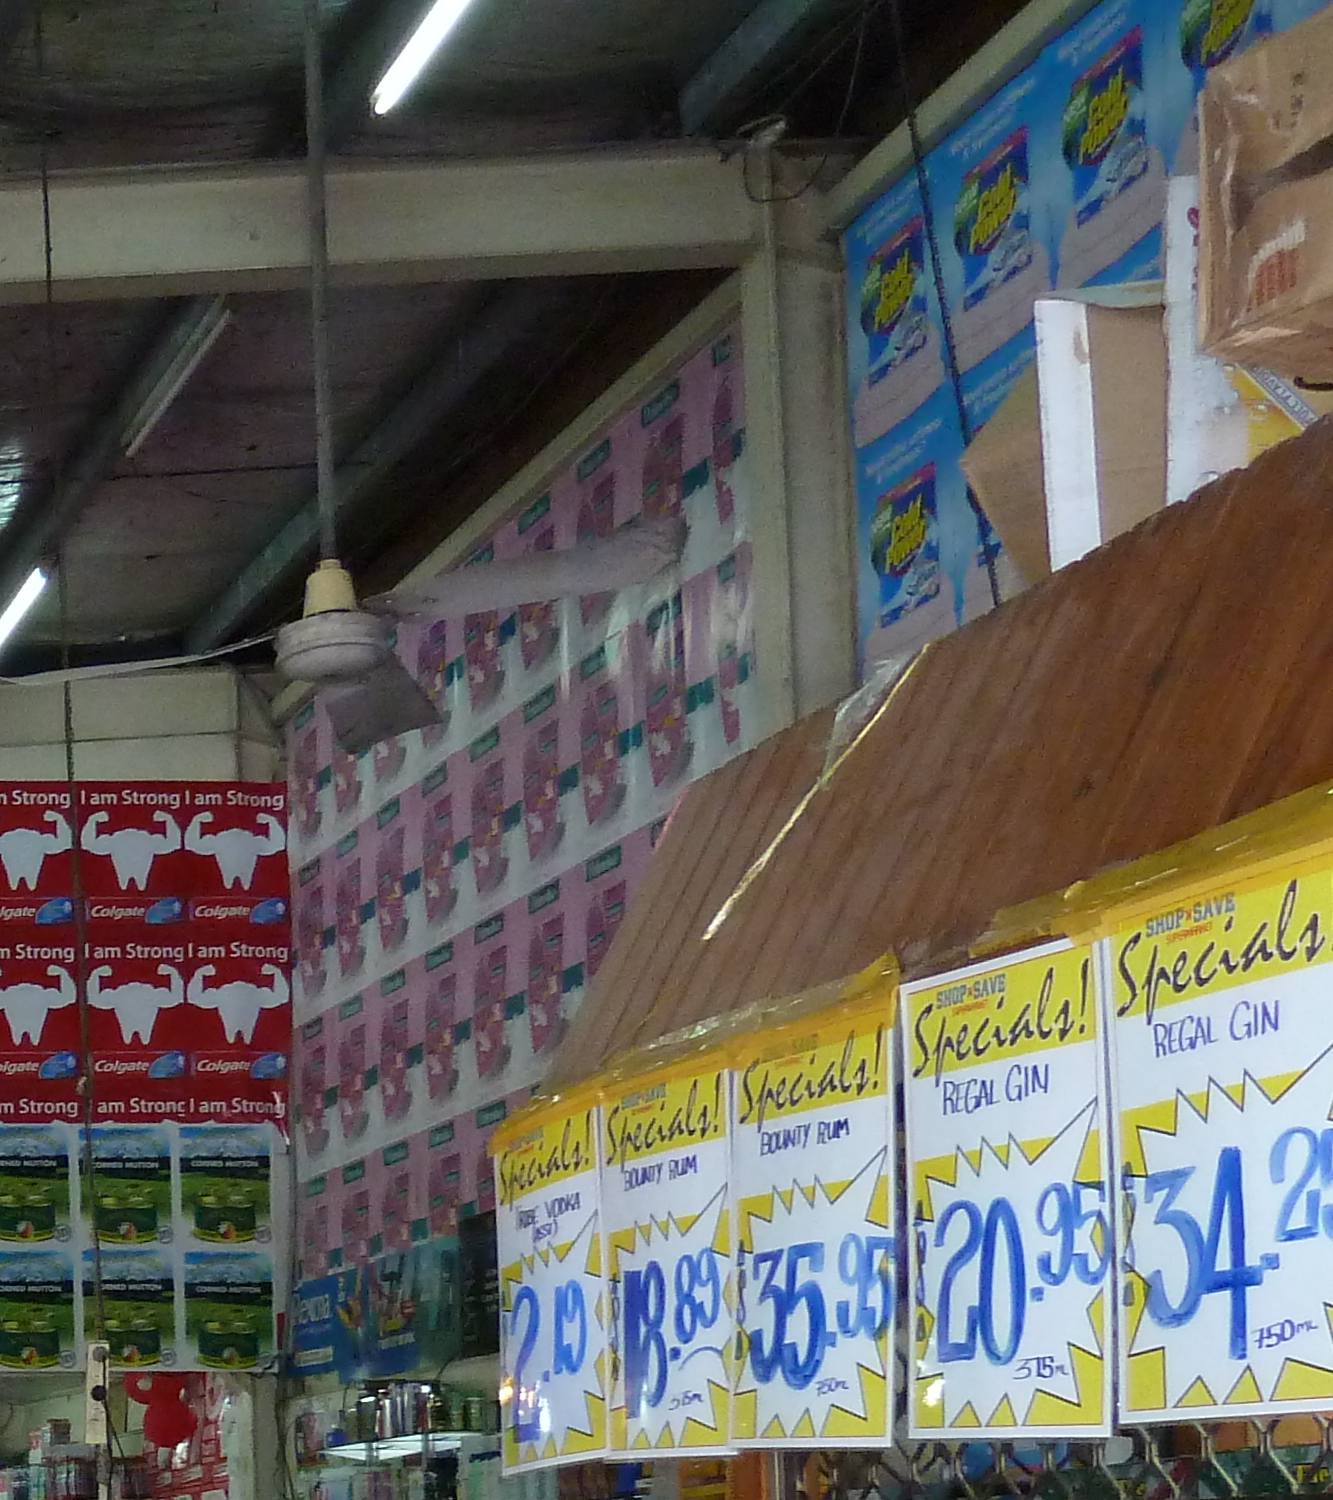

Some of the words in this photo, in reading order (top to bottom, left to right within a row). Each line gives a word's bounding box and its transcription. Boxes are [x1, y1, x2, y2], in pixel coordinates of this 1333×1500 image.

[12, 791, 71, 808] Strong
[195, 793, 221, 805] am
[226, 791, 284, 810] Strong
[1146, 907, 1184, 938] SHOP
[1193, 892, 1237, 923] SAVE
[1117, 878, 1327, 1026] Specials
[936, 985, 968, 1011] SHOP
[973, 973, 1007, 1002] SAVE
[912, 958, 1090, 1087] Specials!
[1153, 1014, 1218, 1059] REGAL
[1229, 1000, 1281, 1042] GIN
[197, 1059, 251, 1074] Colgate
[739, 1023, 884, 1133] Specials!
[942, 1078, 1001, 1117] REGAL
[1005, 1064, 1051, 1103] GIN
[606, 1072, 722, 1173] Specials!
[817, 1117, 850, 1146] RUM
[499, 1109, 592, 1212] Specials!
[934, 1181, 1111, 1367] 20.95
[750, 1232, 896, 1392] 35.95
